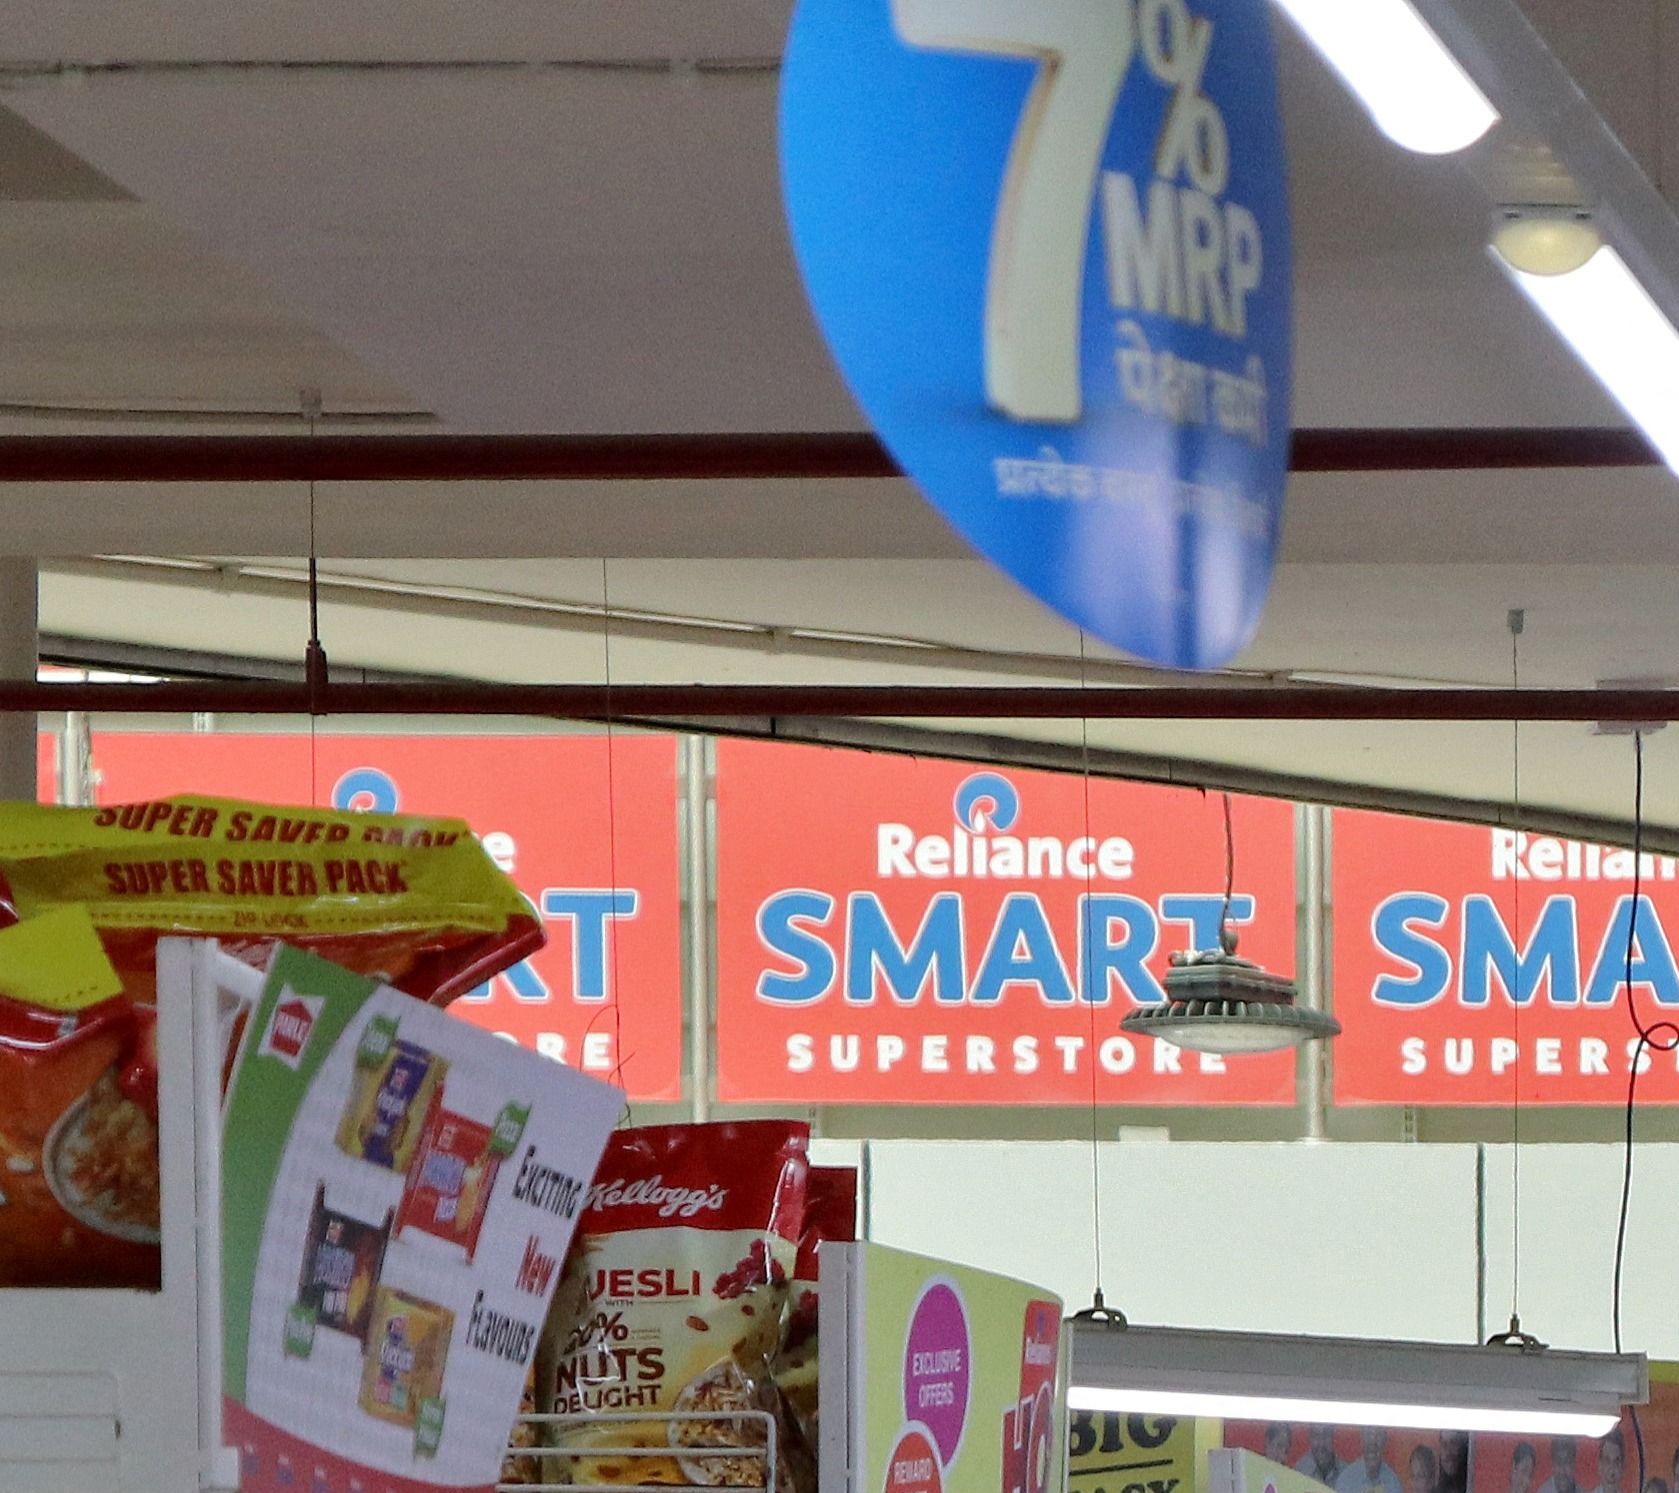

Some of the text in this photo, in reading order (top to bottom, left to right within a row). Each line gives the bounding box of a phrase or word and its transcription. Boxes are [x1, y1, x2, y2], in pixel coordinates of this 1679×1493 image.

[1102, 172, 1265, 338] MRP
[95, 801, 219, 839] SUPER
[876, 820, 1134, 879] Reliance
[104, 857, 409, 897] SUPER SAVER PACK
[755, 888, 1256, 1007] SMART
[786, 1032, 1228, 1075] SUPERSTORE
[587, 1174, 730, 1218] Kellogg's
[588, 1268, 701, 1301] UESLI
[556, 1347, 666, 1393] NUTS
[912, 1348, 962, 1377] EXCLUSIVE
[917, 1381, 955, 1408] OFFERS
[1069, 1410, 1179, 1453] BIG
[894, 1457, 932, 1483] REWARD
